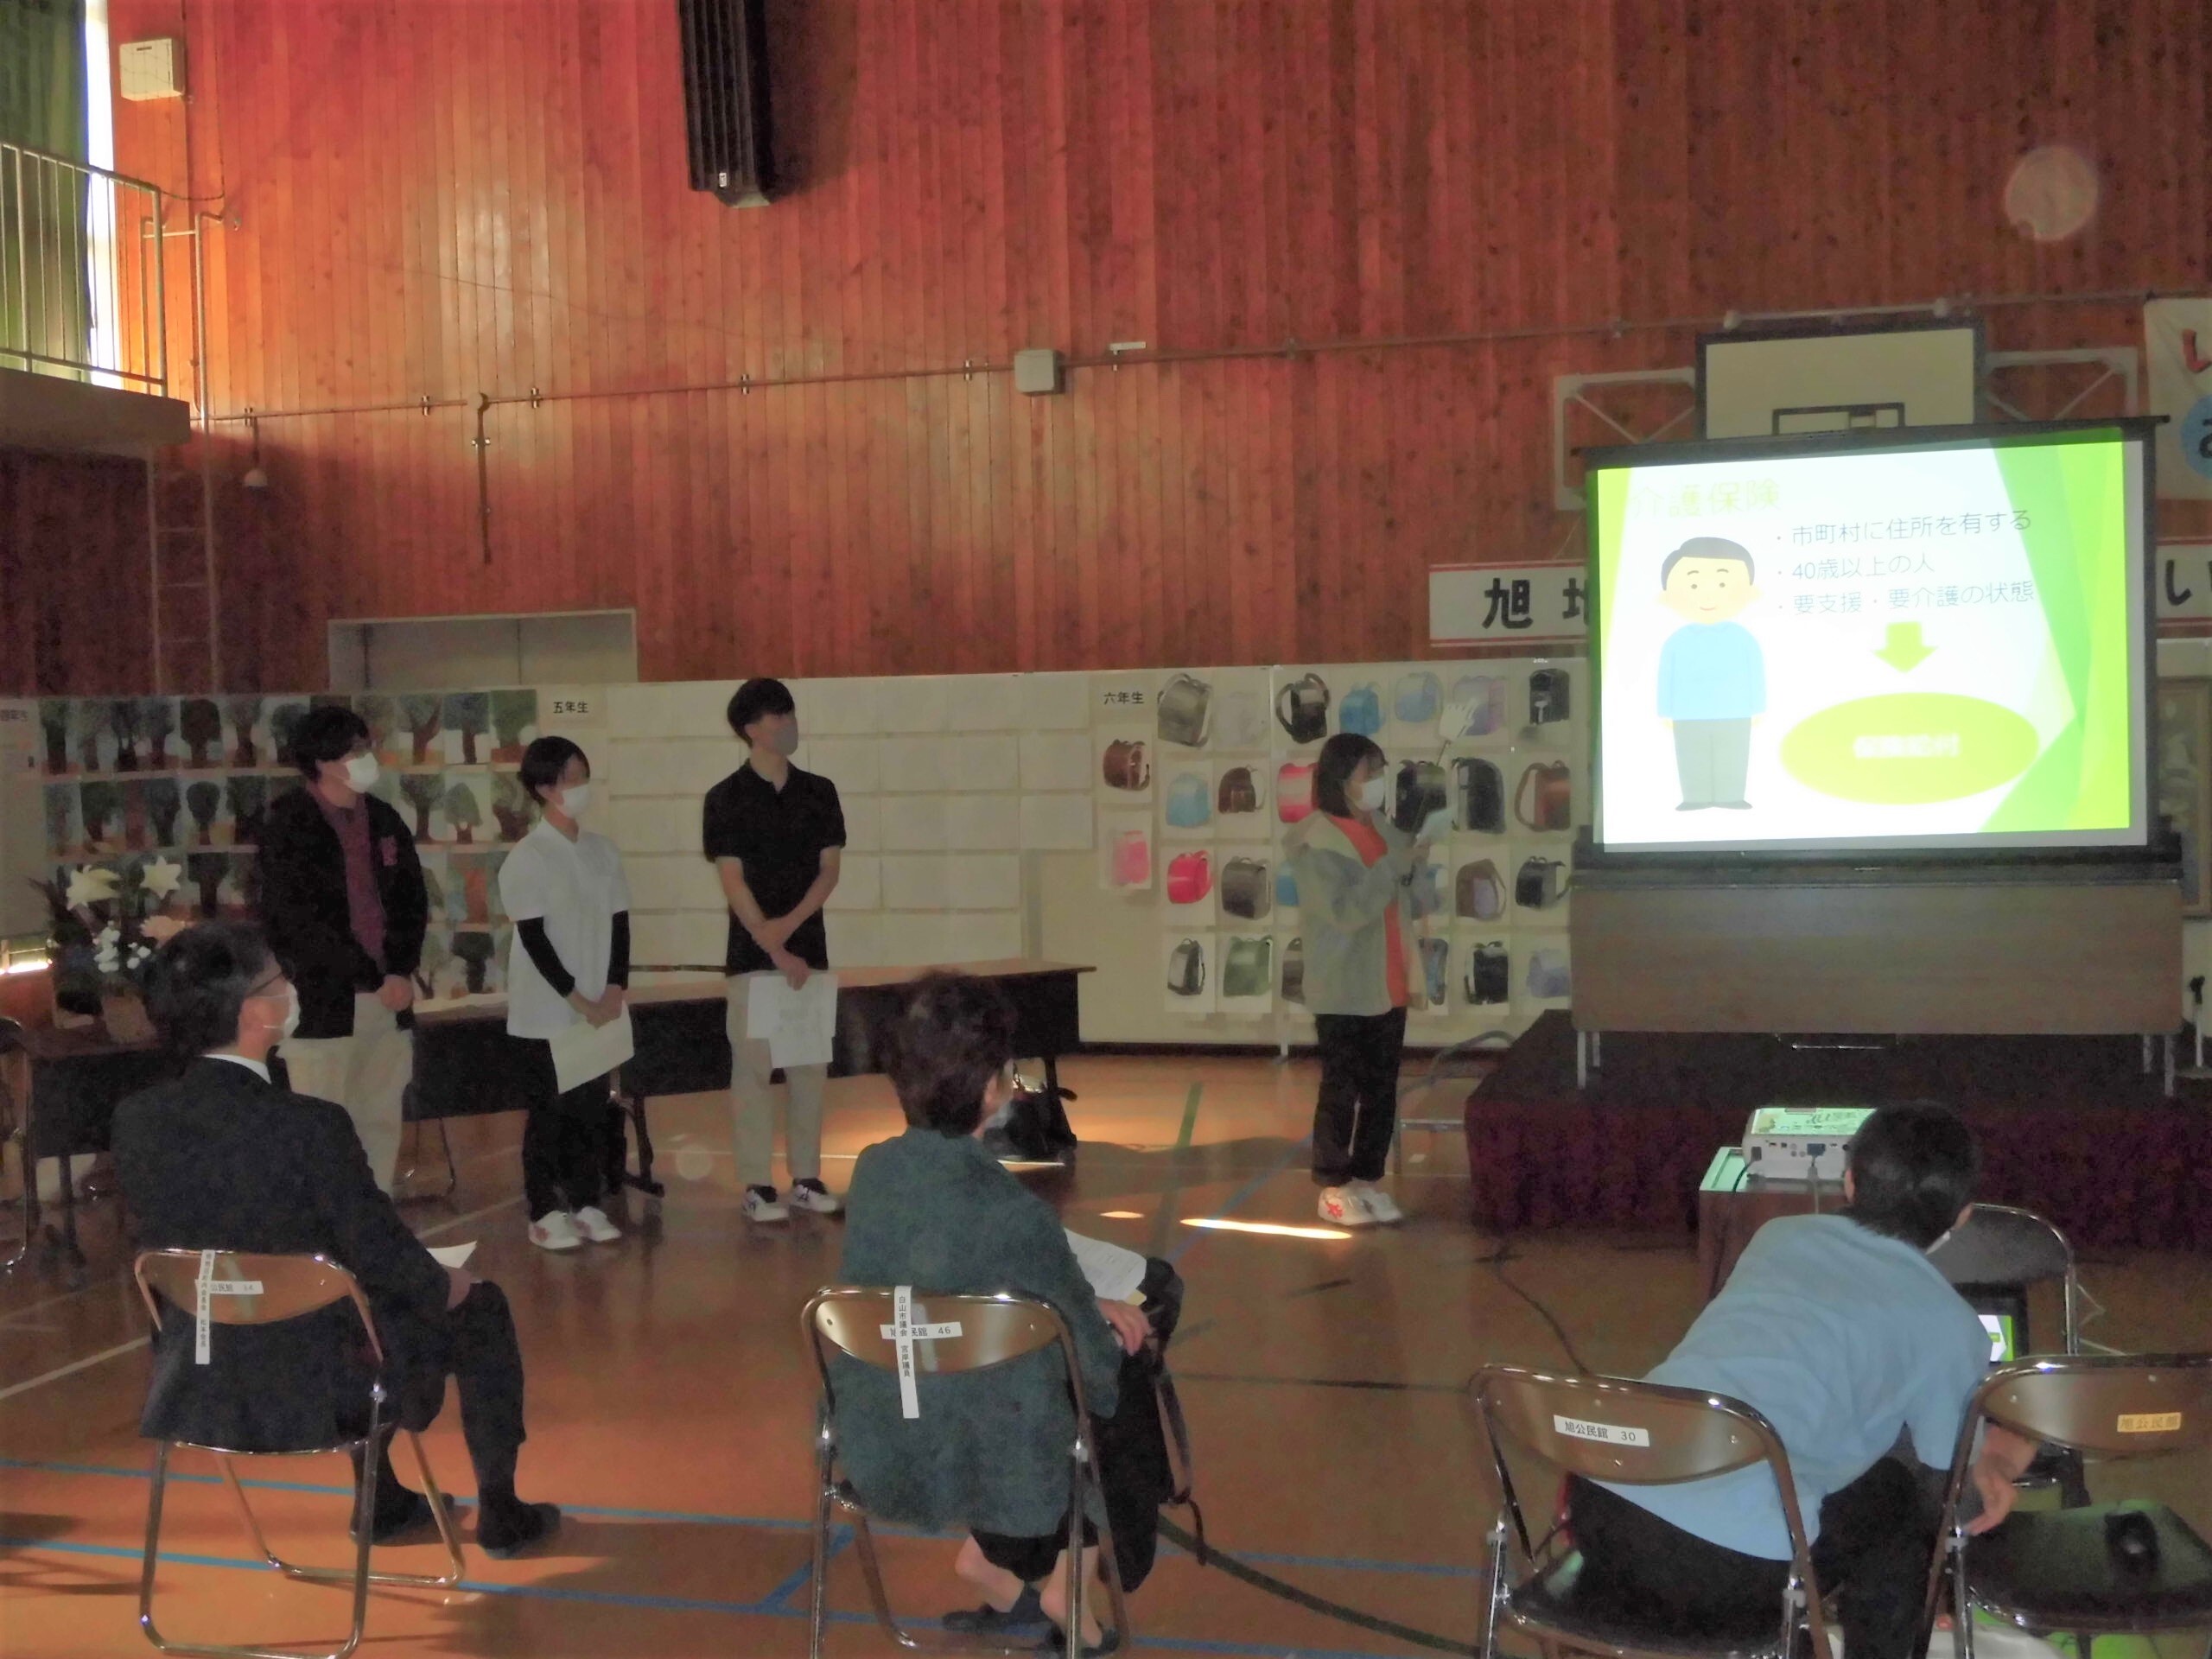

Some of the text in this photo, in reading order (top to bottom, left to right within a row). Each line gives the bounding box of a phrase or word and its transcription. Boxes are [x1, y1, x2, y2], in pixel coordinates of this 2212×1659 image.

[1631, 478, 1781, 518] 介護保険
[1103, 691, 1144, 704] 六年生
[553, 701, 588, 713] 五年生
[899, 1296, 907, 1337] 白山市議会
[938, 1326, 950, 1335] 46
[1565, 1421, 1636, 1441] 旭公民館 30
